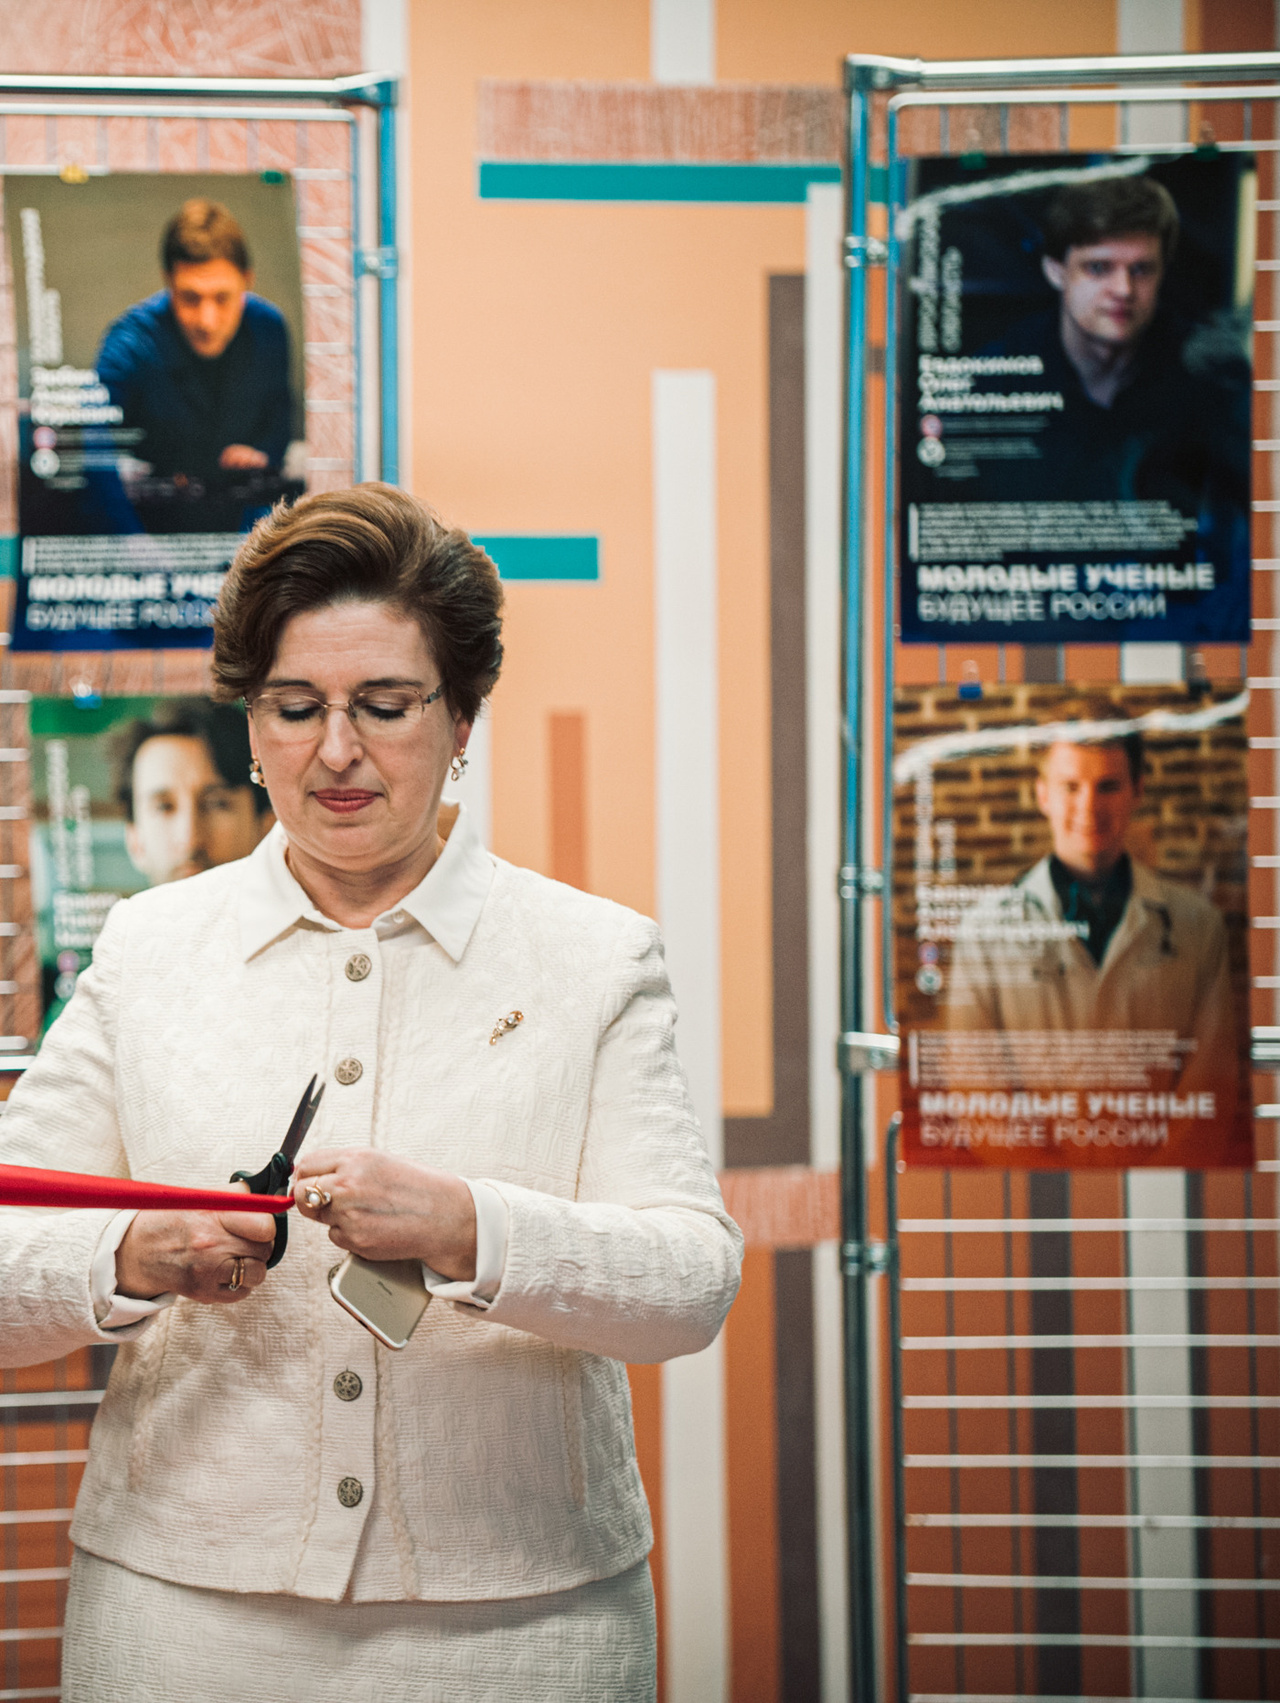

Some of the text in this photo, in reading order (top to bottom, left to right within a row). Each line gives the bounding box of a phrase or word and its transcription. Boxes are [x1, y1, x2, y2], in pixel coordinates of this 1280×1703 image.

[28, 574, 167, 602] МОЛОДЫЕ
[918, 563, 1215, 594] МОЛОДЫЕ УЧЕНЫЕ
[26, 602, 138, 632] БУДУЩЕЕ
[918, 594, 1167, 624] БУДУЩЕЕ РОССИИ
[920, 1091, 1215, 1121] МОЛОДЫЕ УЧЕНЫЕ
[920, 1120, 1168, 1149] БУДУЩЕЕ РОССИИ
